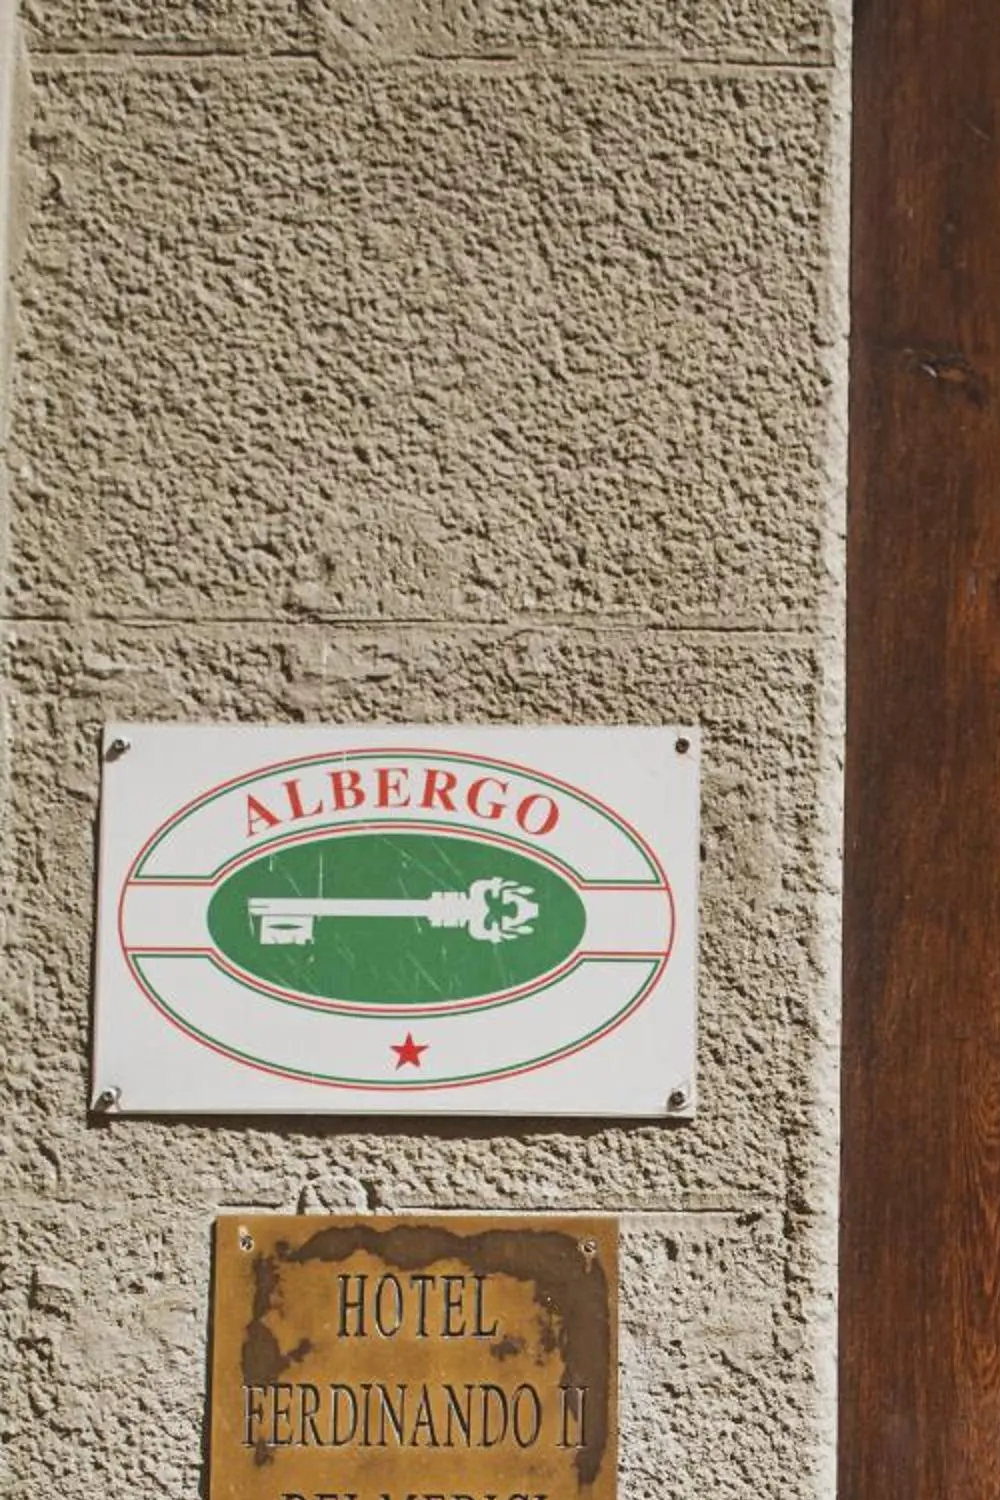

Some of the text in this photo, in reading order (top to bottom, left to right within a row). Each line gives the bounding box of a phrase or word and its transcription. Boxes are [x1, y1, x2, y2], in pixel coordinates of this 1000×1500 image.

[244, 767, 561, 838] ALBERGO
[336, 1273, 499, 1339] HOTEL
[241, 1383, 590, 1449] FERDINANDO II
